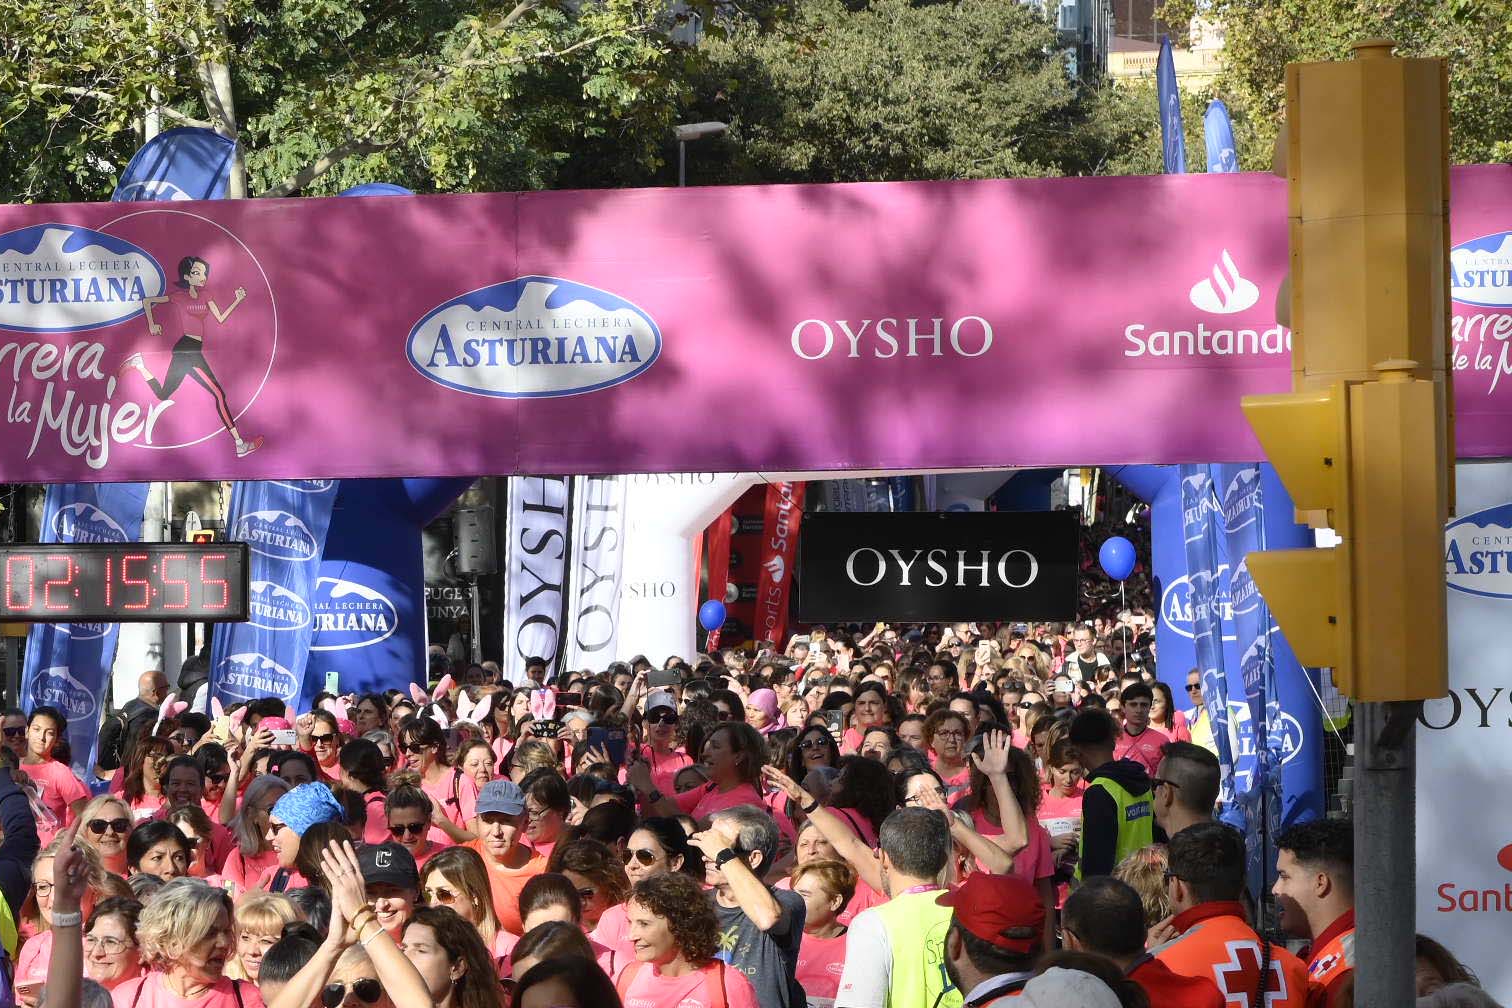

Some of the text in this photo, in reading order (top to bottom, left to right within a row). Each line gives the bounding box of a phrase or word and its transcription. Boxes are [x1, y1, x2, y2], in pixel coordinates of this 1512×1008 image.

[68, 259, 141, 272] LECHERA
[1464, 257, 1512, 266] CENTRA
[465, 317, 633, 331] CENTRAL LECHERA
[790, 314, 993, 360] OYSHO
[426, 320, 642, 370] ASTURIANA
[1475, 343, 1493, 370] la
[5, 386, 32, 424] la
[26, 375, 176, 468] Mujer
[237, 520, 311, 557] ASTURIANA
[5, 554, 229, 610] 02:15:55
[845, 547, 1040, 588] OYSHO
